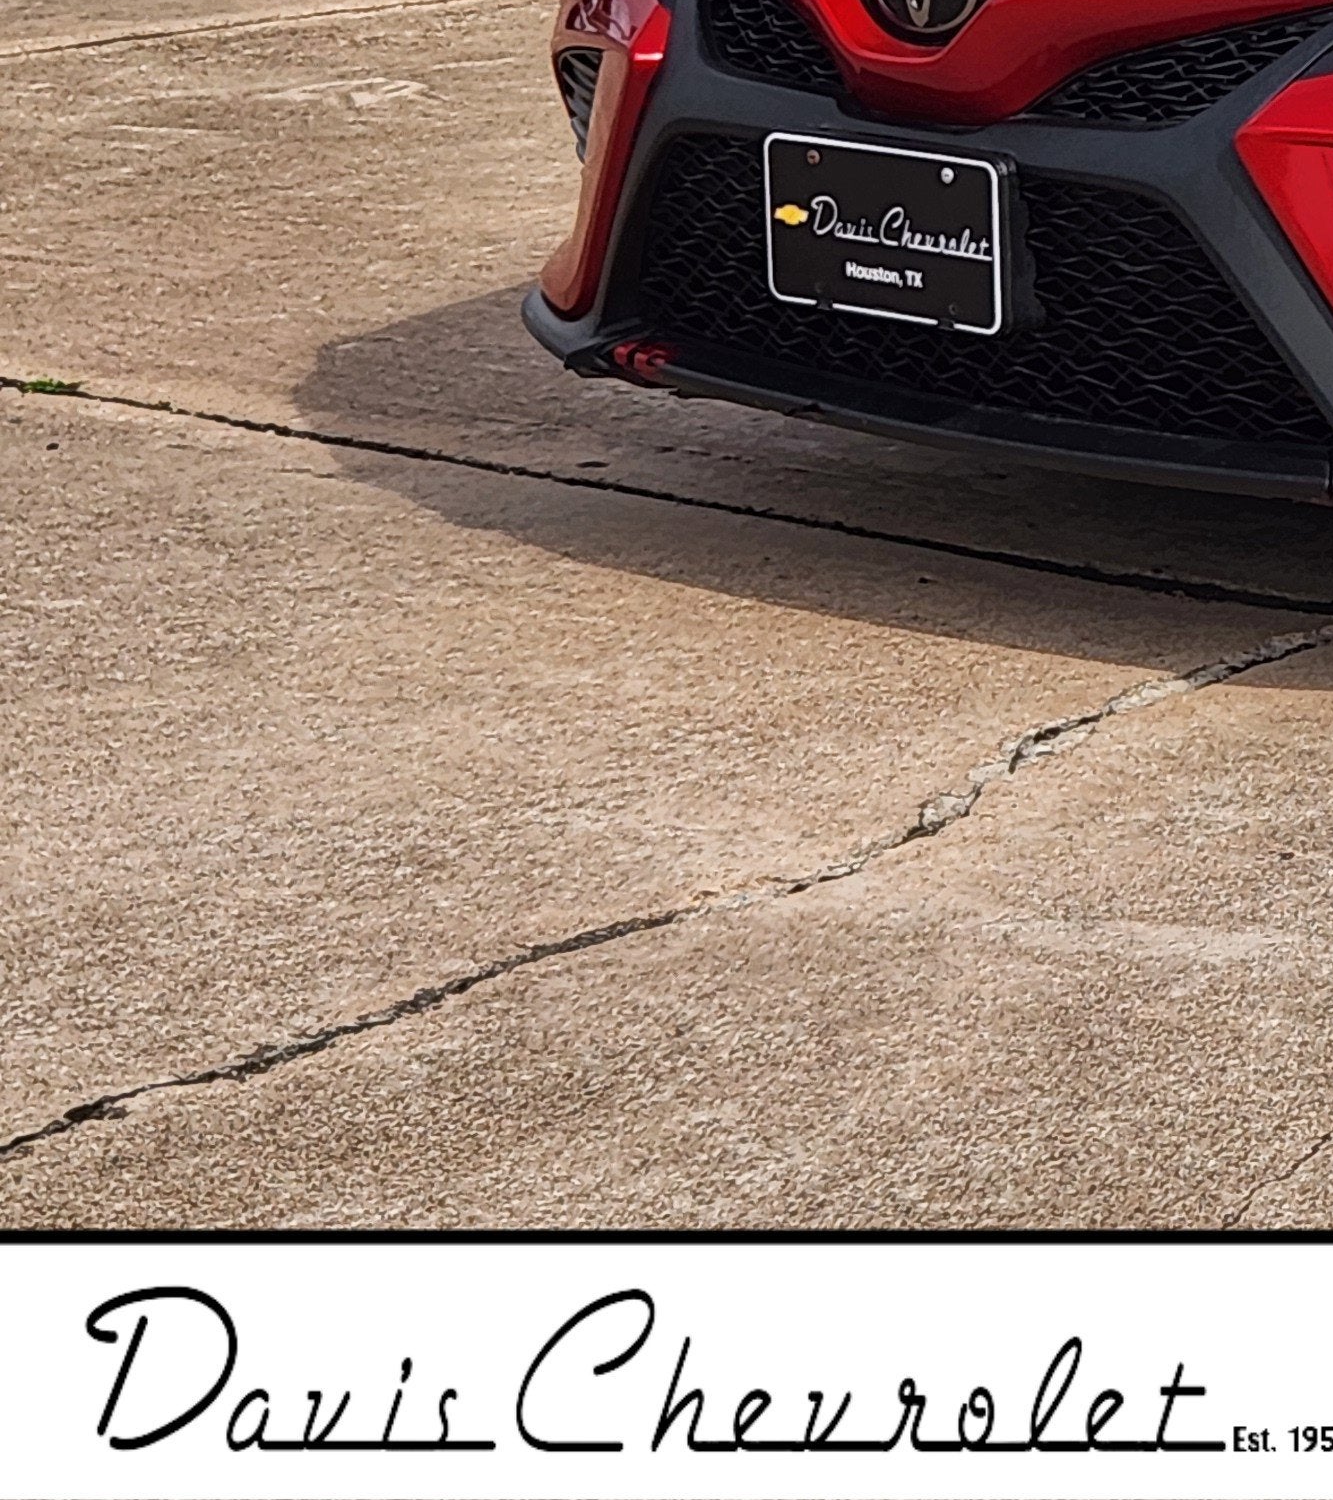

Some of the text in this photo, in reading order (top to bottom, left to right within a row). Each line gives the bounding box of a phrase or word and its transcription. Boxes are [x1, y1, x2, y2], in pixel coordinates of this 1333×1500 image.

[811, 195, 993, 262] Davis Chevrolet
[846, 261, 923, 288] Houston, TX
